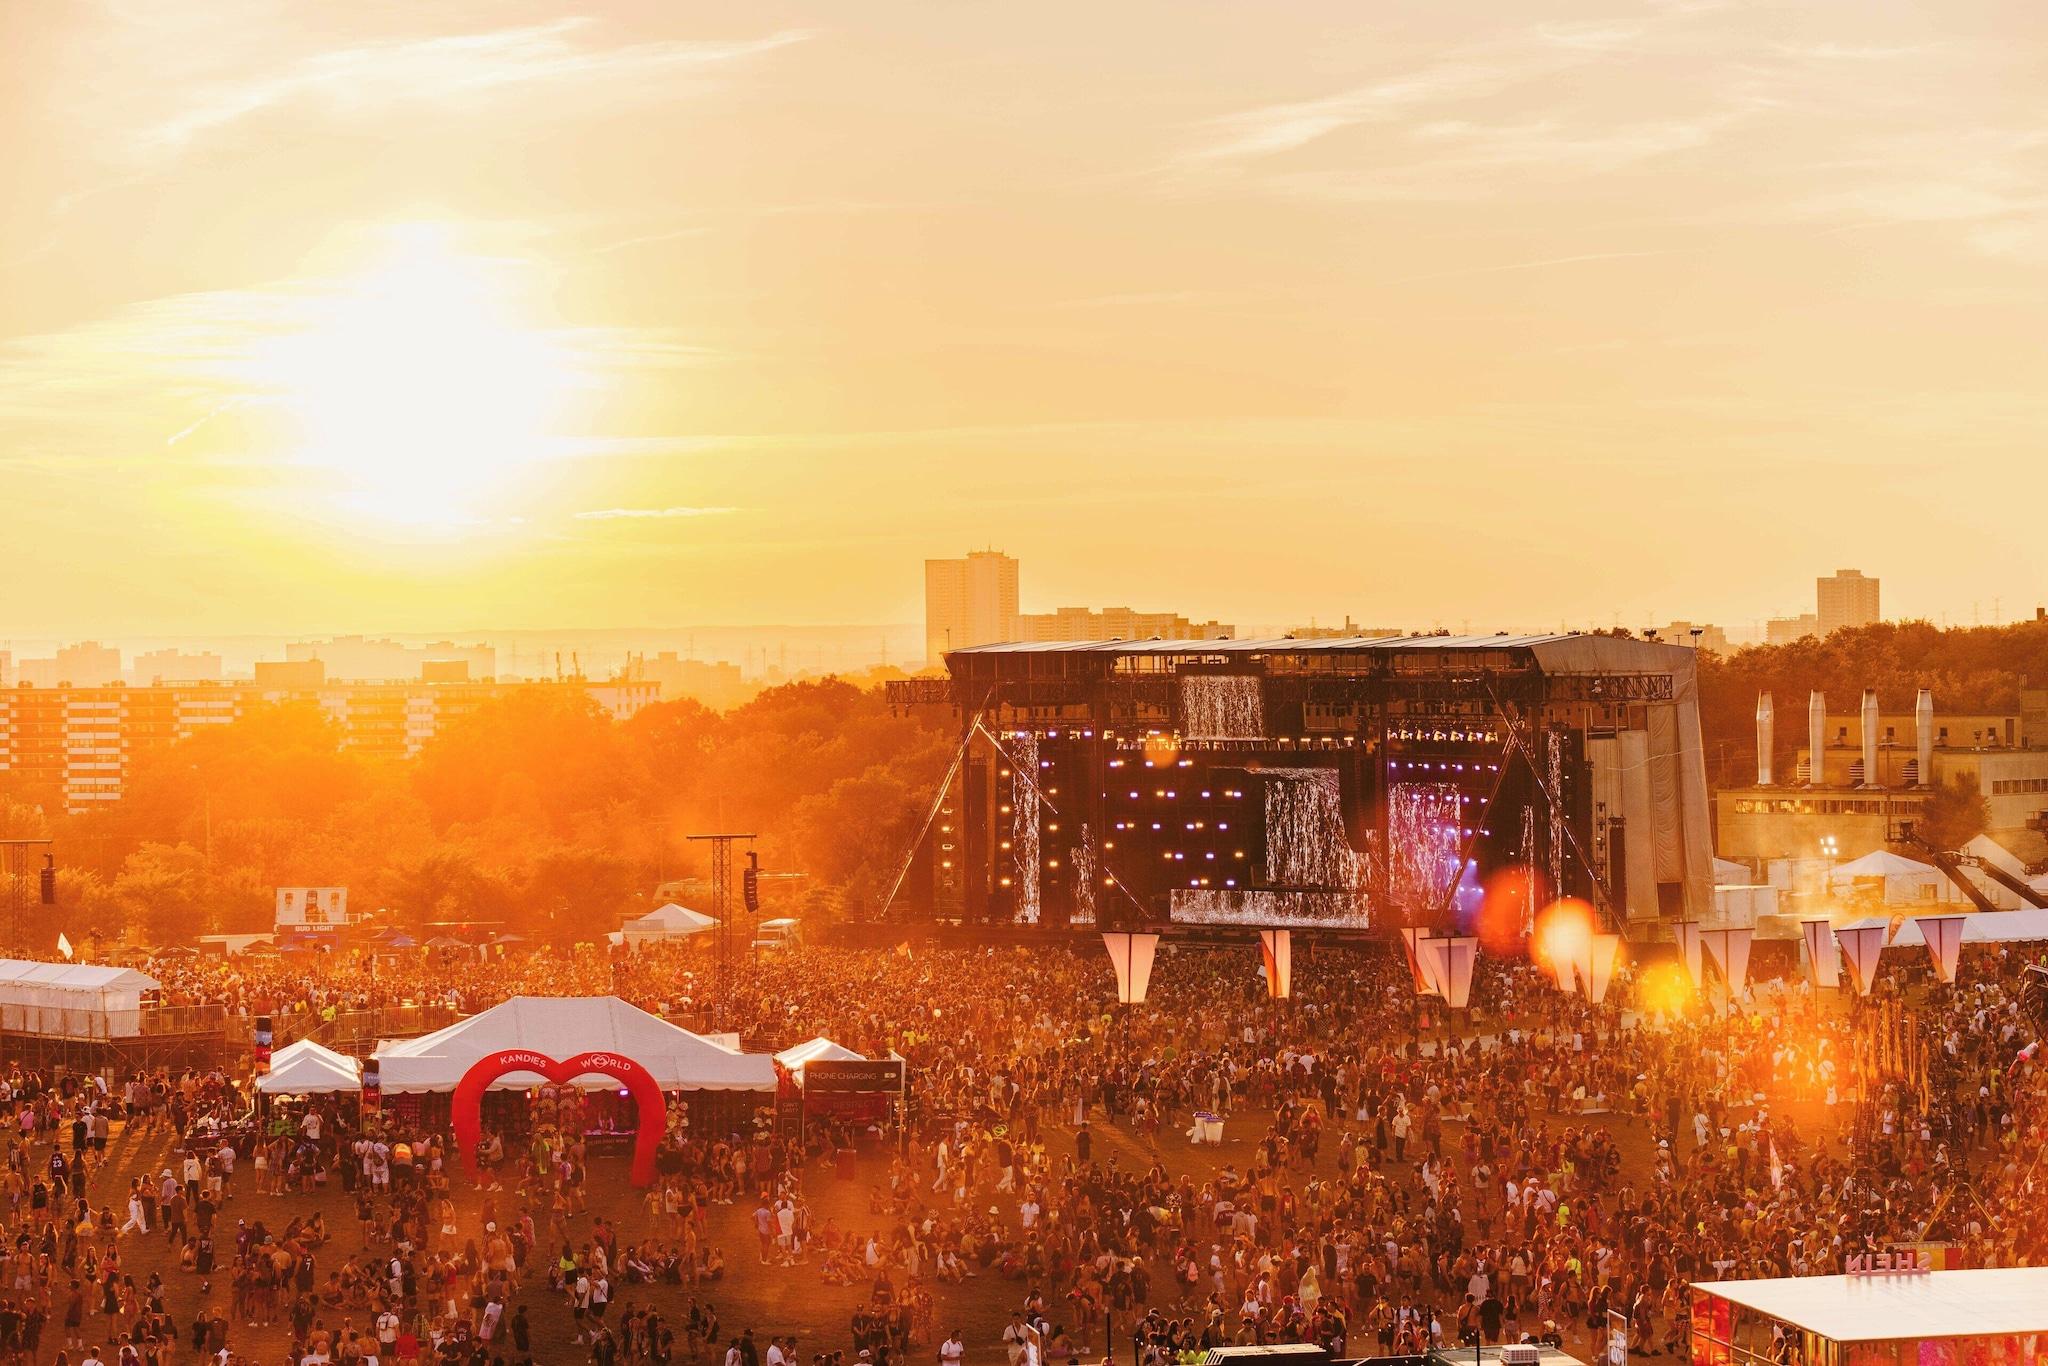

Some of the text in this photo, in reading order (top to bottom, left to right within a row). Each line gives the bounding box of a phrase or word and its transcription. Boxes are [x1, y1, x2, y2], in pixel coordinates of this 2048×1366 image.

[499, 1053, 547, 1069] KANDIES
[809, 1072, 877, 1080] PHONE CHARGING
[52, 1159, 63, 1168] 23
[305, 1262, 311, 1271] 7
[668, 1258, 675, 1269] 7
